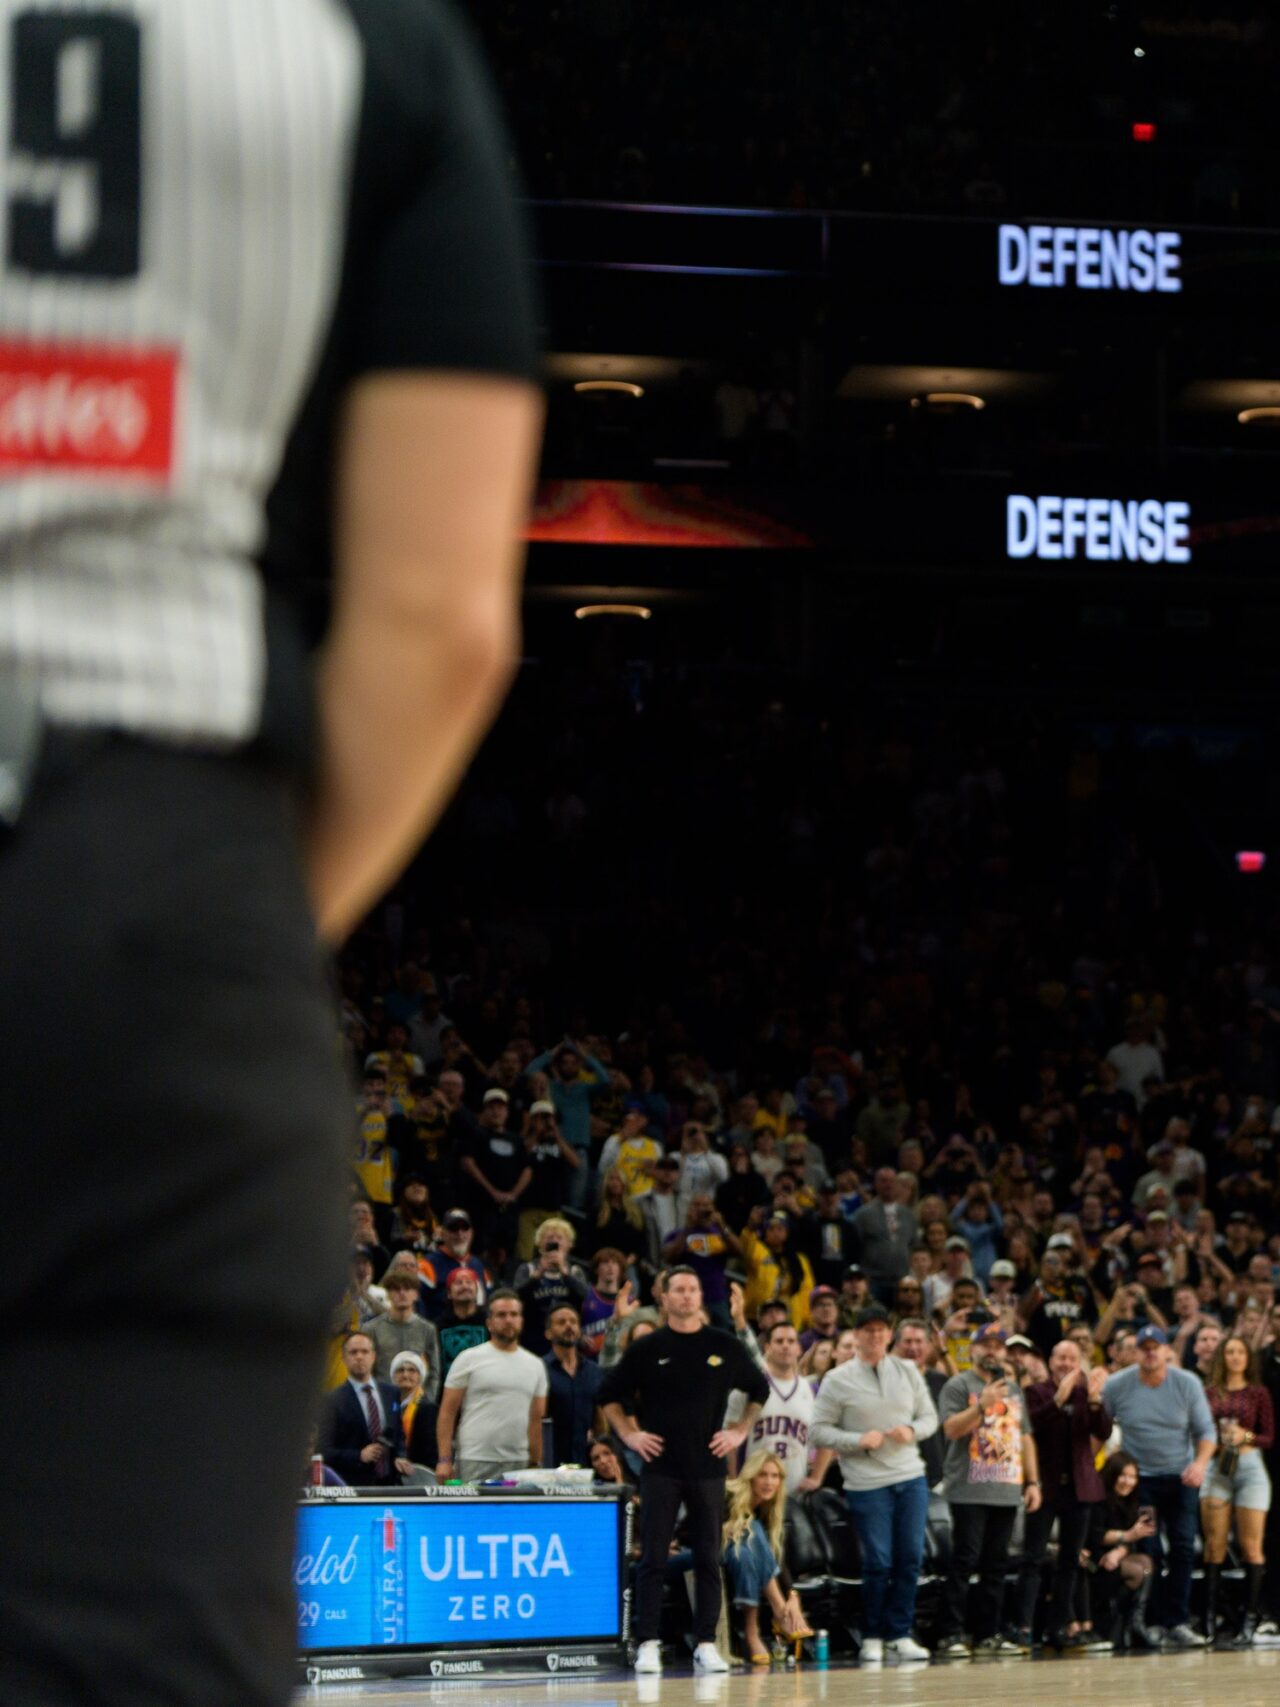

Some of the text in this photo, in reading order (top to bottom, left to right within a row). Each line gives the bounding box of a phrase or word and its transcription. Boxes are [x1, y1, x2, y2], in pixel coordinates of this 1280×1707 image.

[10, 12, 141, 280] 9
[998, 223, 1182, 293] DEFENSE
[1006, 494, 1192, 564] DEFENSE
[753, 1415, 808, 1447] SUNS
[419, 1533, 571, 1581] ULTRA
[448, 1593, 536, 1621] ZERO
[321, 1667, 364, 1680] FANDUEL
[443, 1660, 484, 1673] FANDUEL
[559, 1655, 598, 1667] FANDUEL
